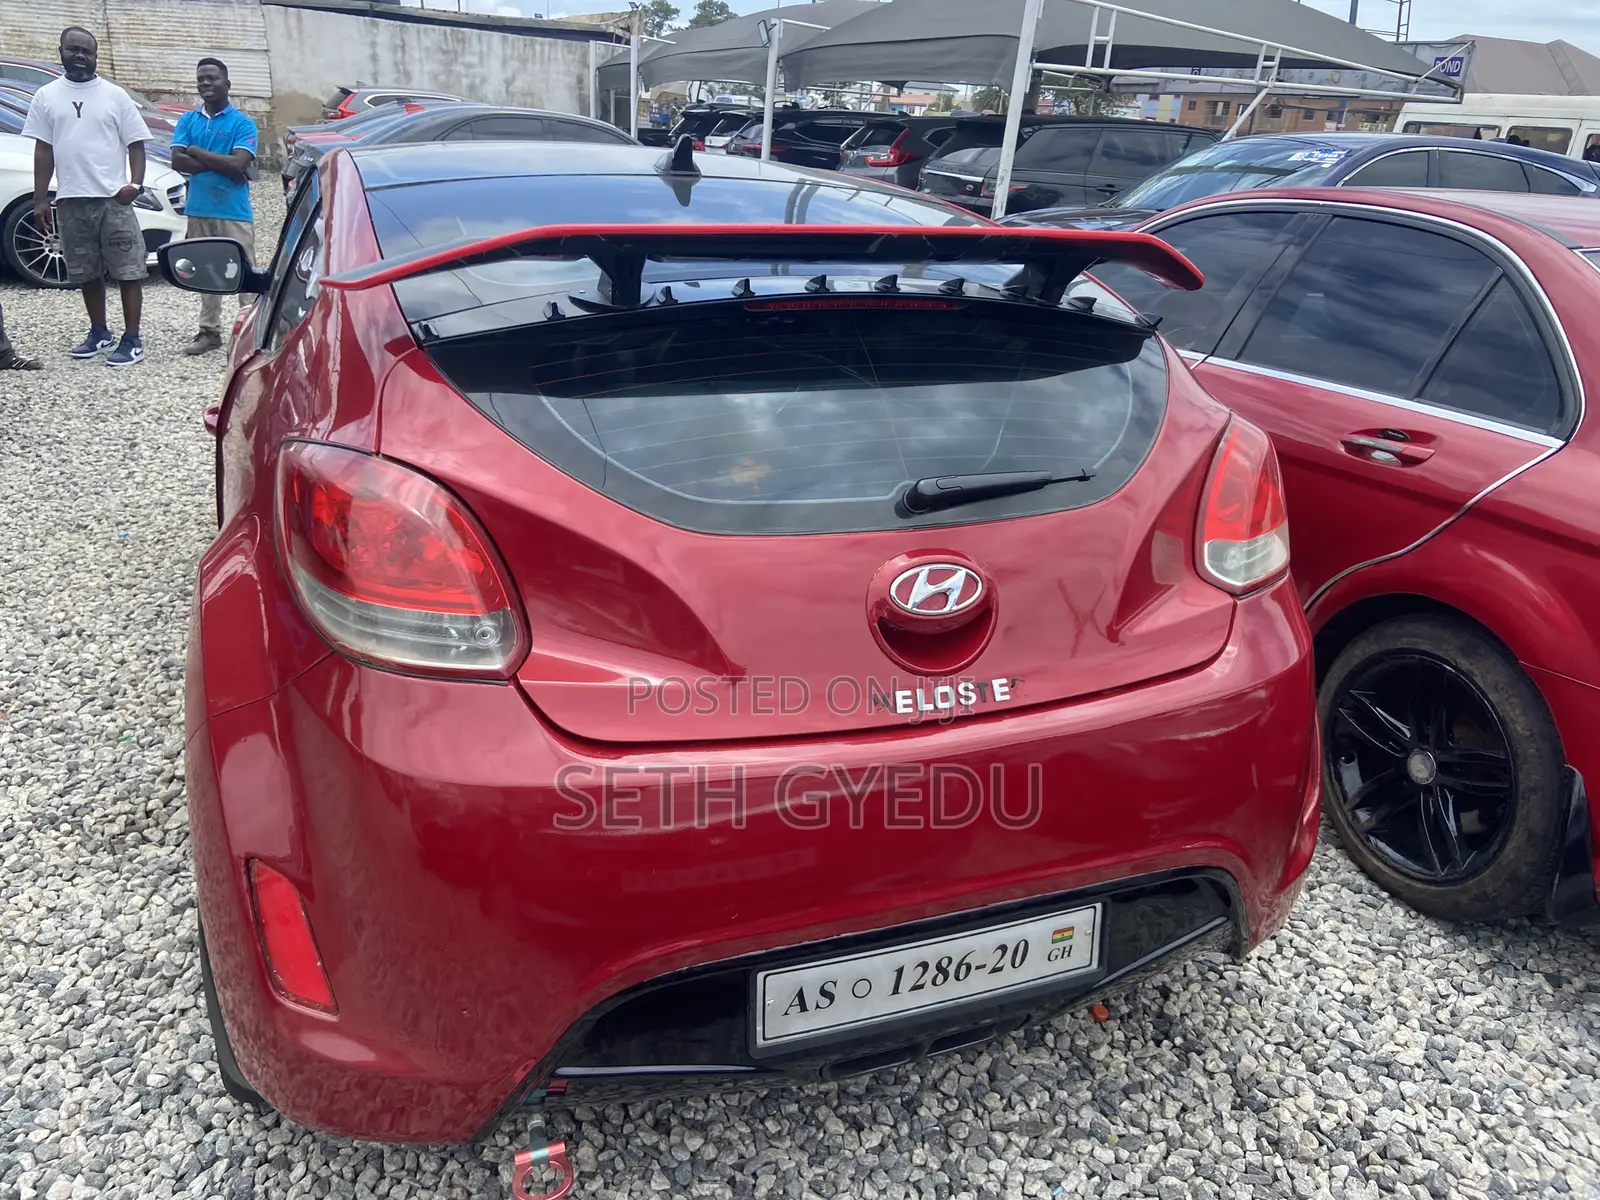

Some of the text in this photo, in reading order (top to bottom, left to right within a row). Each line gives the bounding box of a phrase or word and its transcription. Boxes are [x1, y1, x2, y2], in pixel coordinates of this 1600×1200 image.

[71, 101, 84, 119] Y
[1046, 944, 1073, 963] GH
[781, 938, 1031, 1017] AS 1286-20
